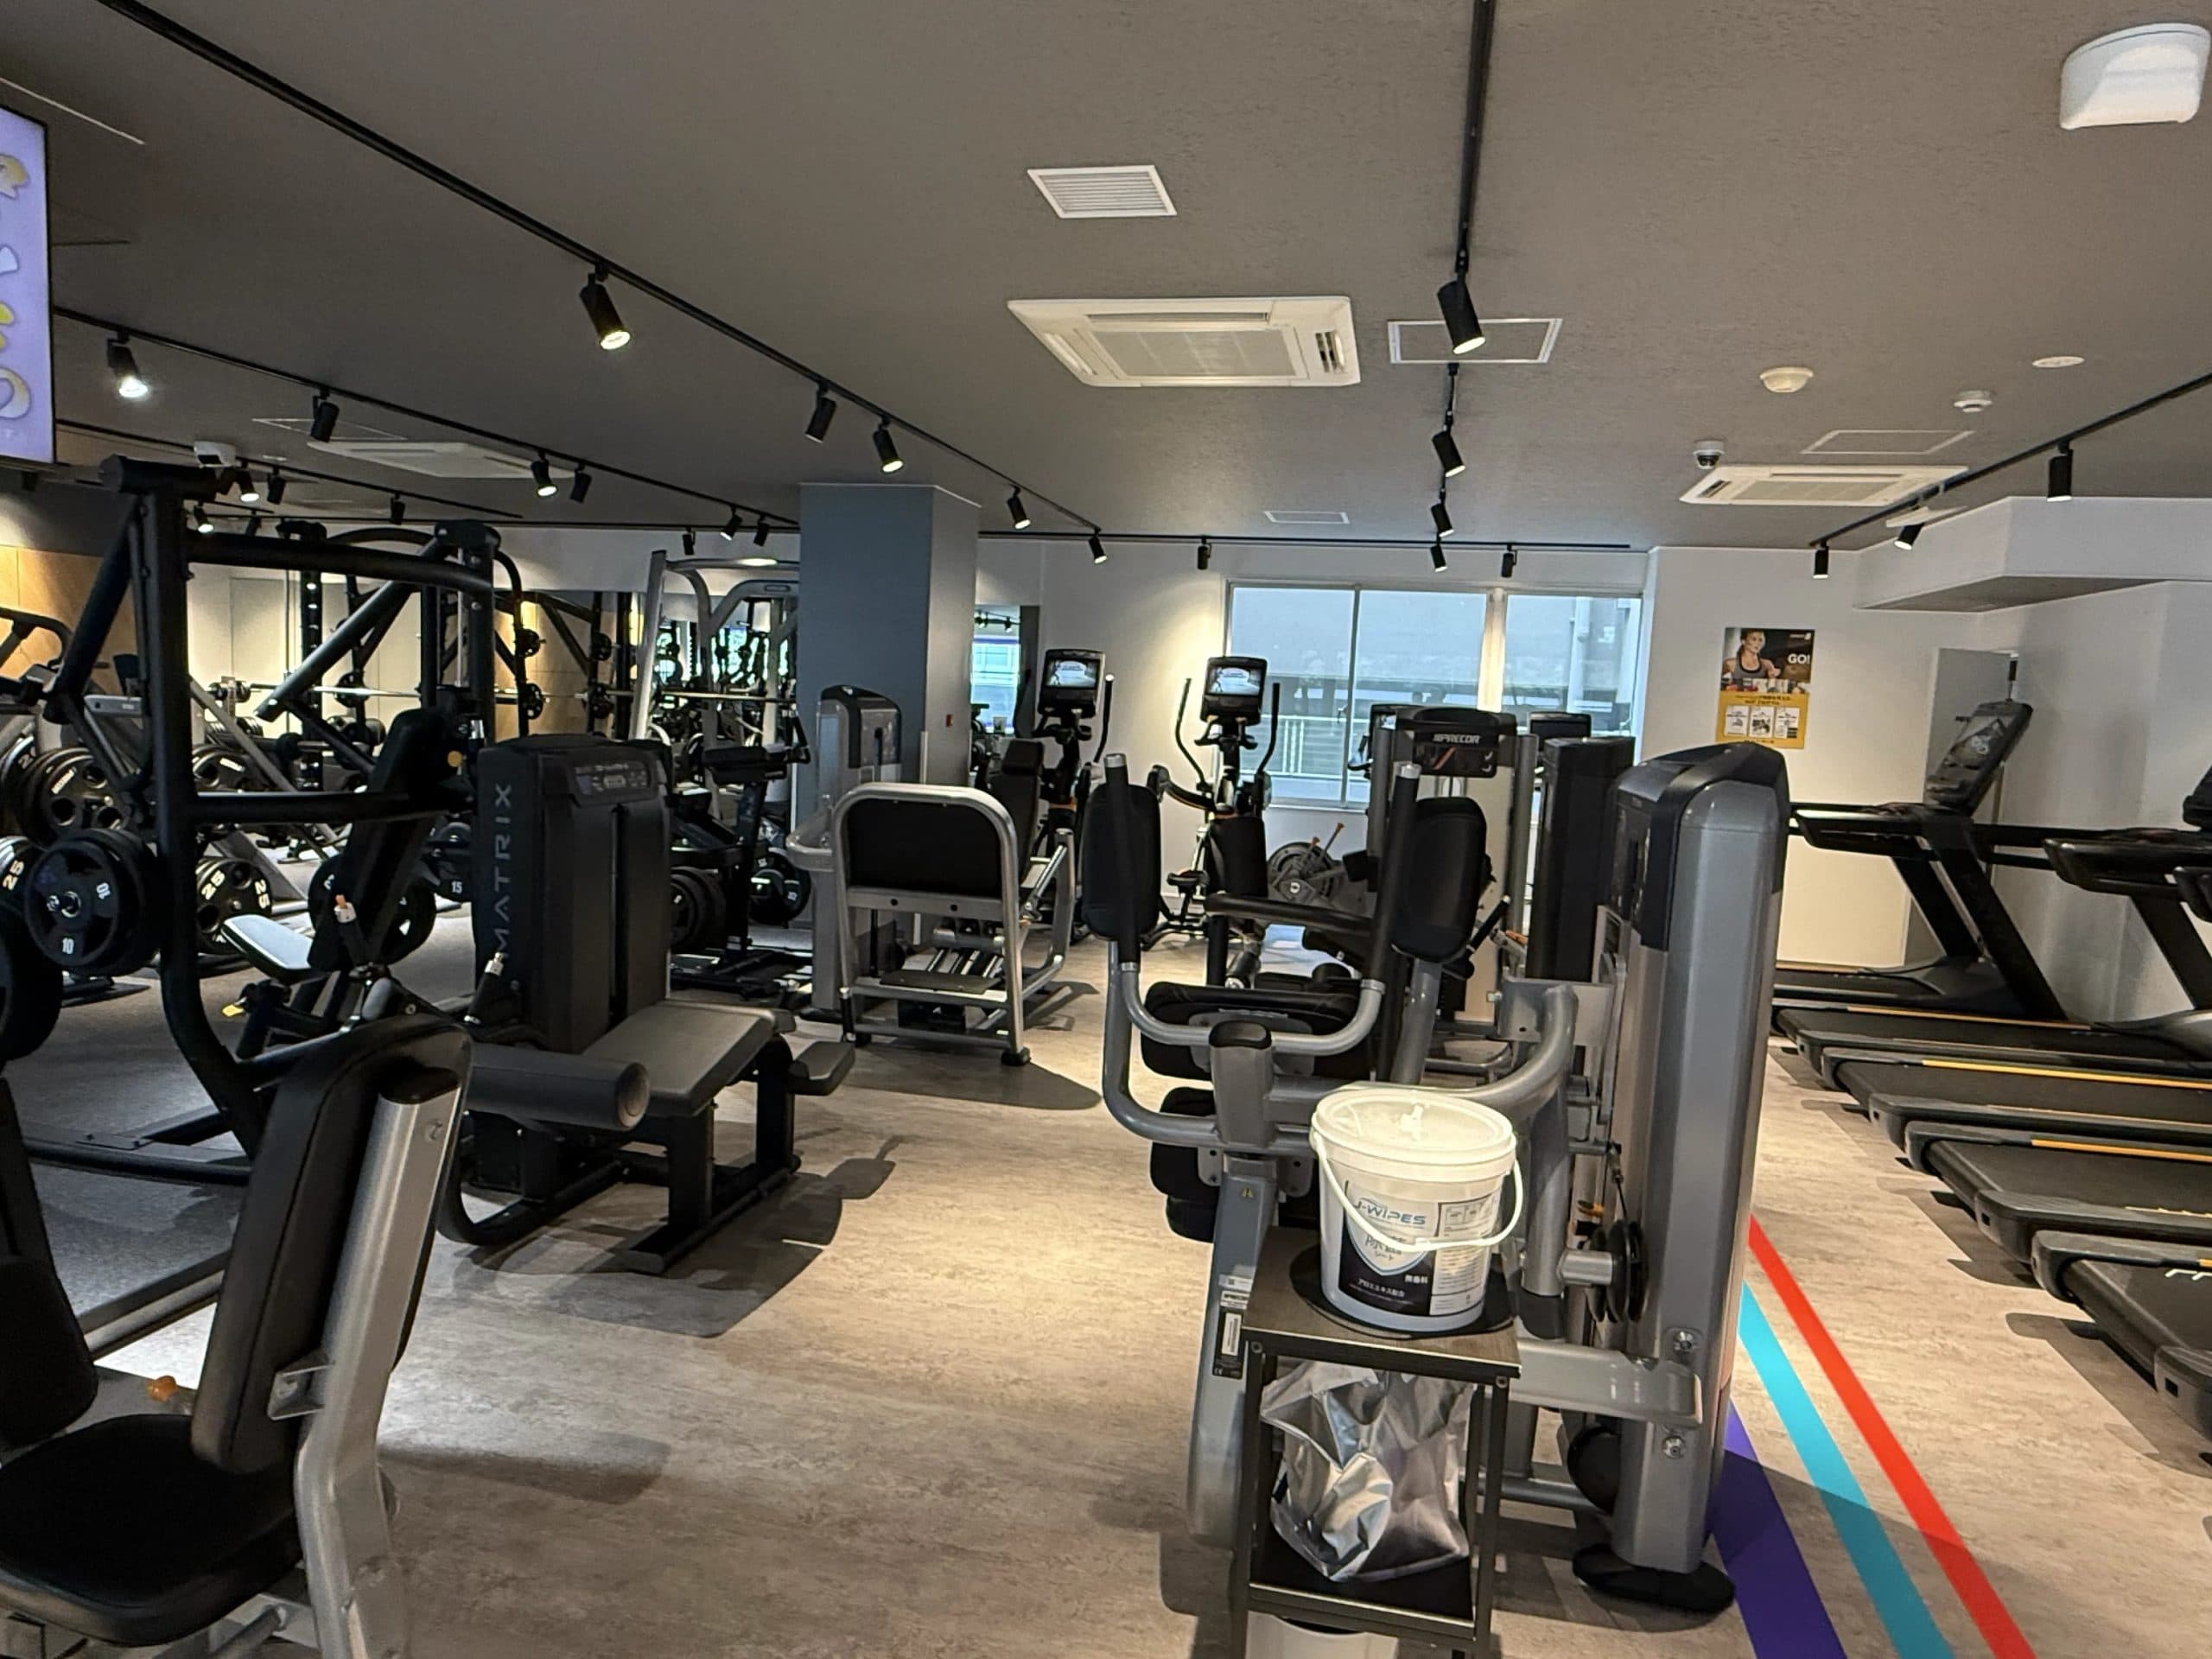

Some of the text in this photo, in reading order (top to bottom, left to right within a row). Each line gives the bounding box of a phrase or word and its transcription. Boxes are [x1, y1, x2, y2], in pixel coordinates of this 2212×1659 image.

[1788, 653, 1810, 664] GO!
[1439, 733, 1481, 744] PRECOR
[2, 860, 25, 891] 25
[494, 783, 512, 957] MATRIX
[96, 882, 111, 900] 10
[201, 869, 226, 900] 25
[451, 880, 463, 893] 15
[254, 879, 270, 909] 25
[61, 937, 74, 955] 10
